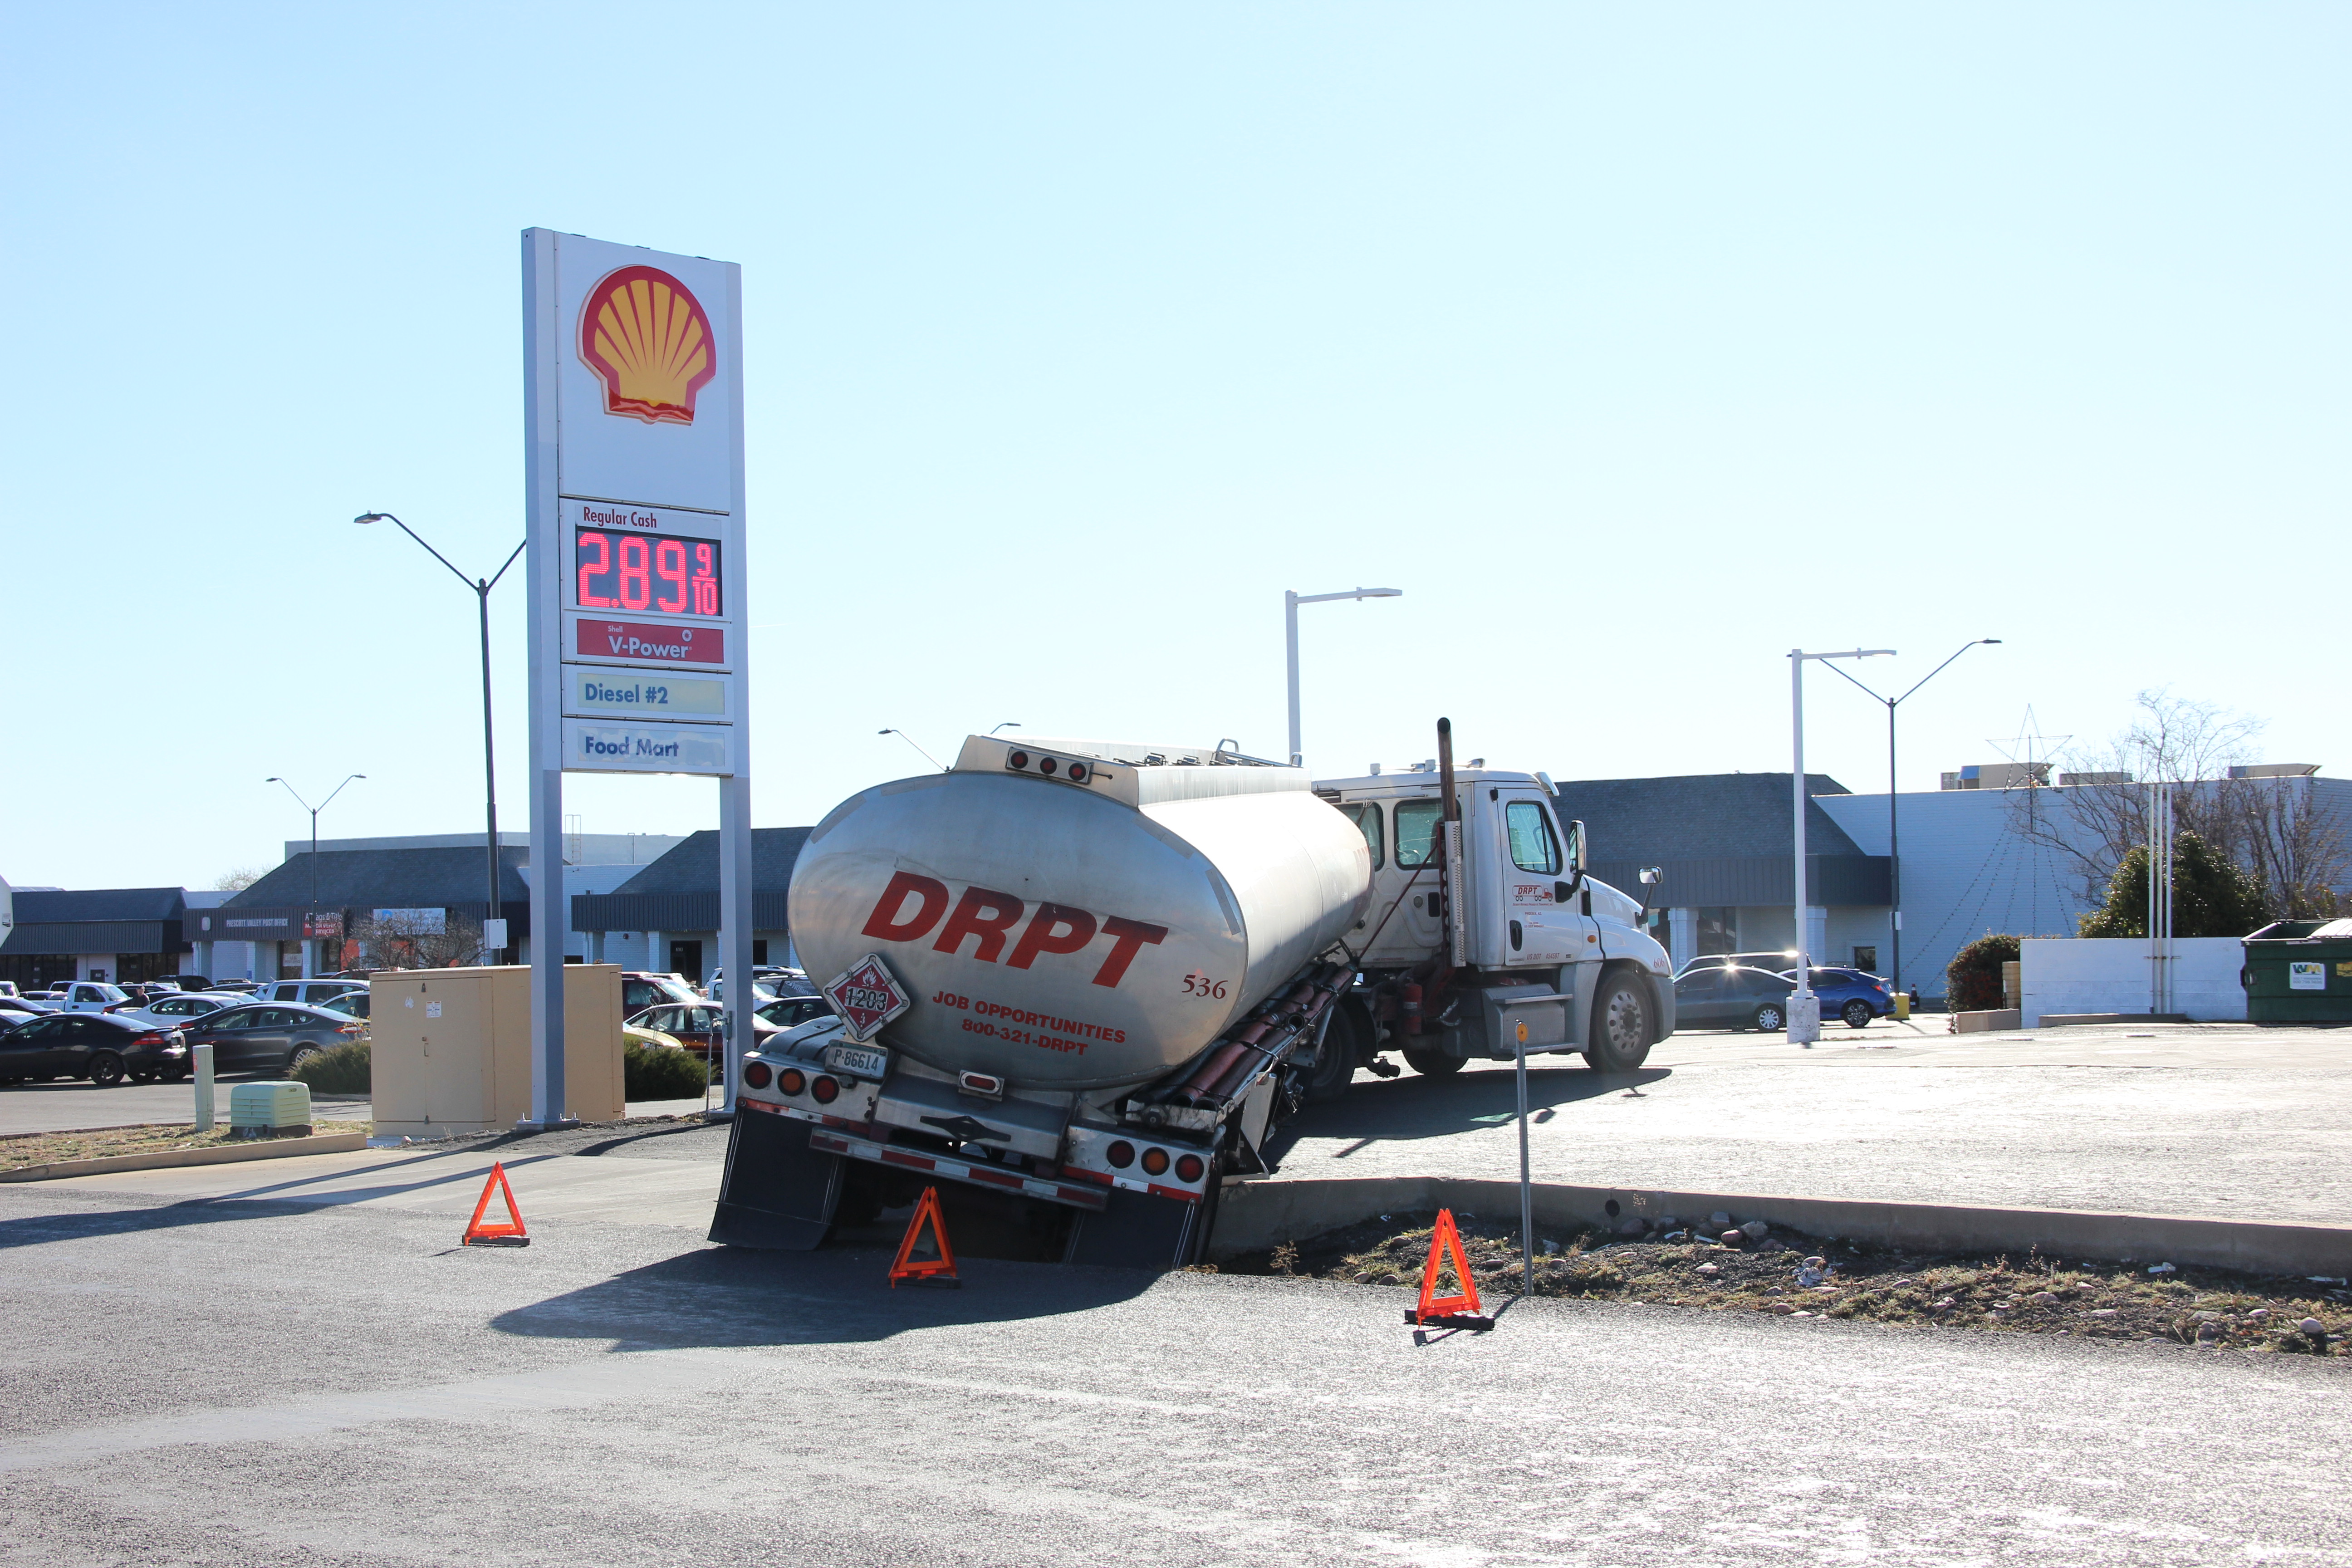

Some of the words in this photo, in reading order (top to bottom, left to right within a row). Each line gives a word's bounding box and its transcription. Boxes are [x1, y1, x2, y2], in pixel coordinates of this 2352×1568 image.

[583, 507, 627, 528] Regular
[631, 512, 657, 529] Cash
[579, 532, 687, 613] 2.89
[608, 635, 689, 659] V-Power
[585, 683, 640, 704] Diesel
[645, 686, 668, 705] #2
[585, 736, 629, 755] Food
[636, 739, 679, 757] Mart
[861, 870, 1169, 988] DRPT
[1654, 956, 1664, 968] 606
[2293, 965, 2321, 974] WM
[1181, 974, 1229, 999] 536
[846, 987, 886, 1011] 1203
[932, 991, 969, 1010] JOB
[975, 1001, 1126, 1044] OPPORTUNITIES
[962, 1019, 1088, 1056] 800-321-DRPT
